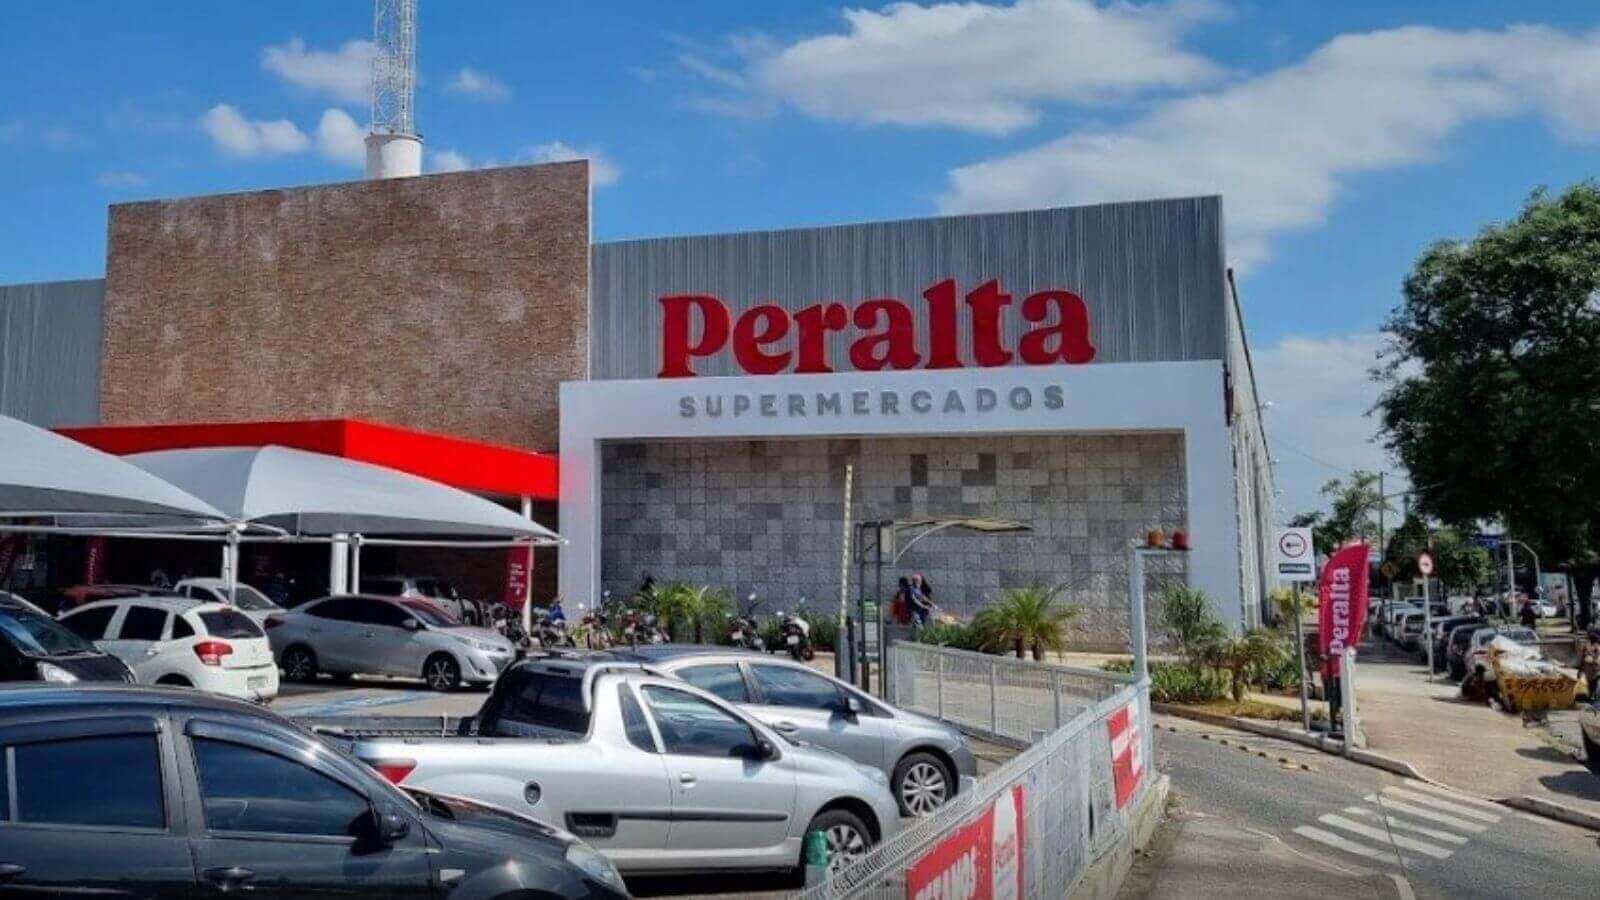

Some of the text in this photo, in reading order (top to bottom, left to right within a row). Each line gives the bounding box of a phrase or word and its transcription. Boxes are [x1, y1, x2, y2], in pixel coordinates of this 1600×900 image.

[658, 278, 1096, 378] Peralta
[679, 385, 1066, 418] SUPERMERCADOS
[1328, 567, 1351, 656] Peralta
